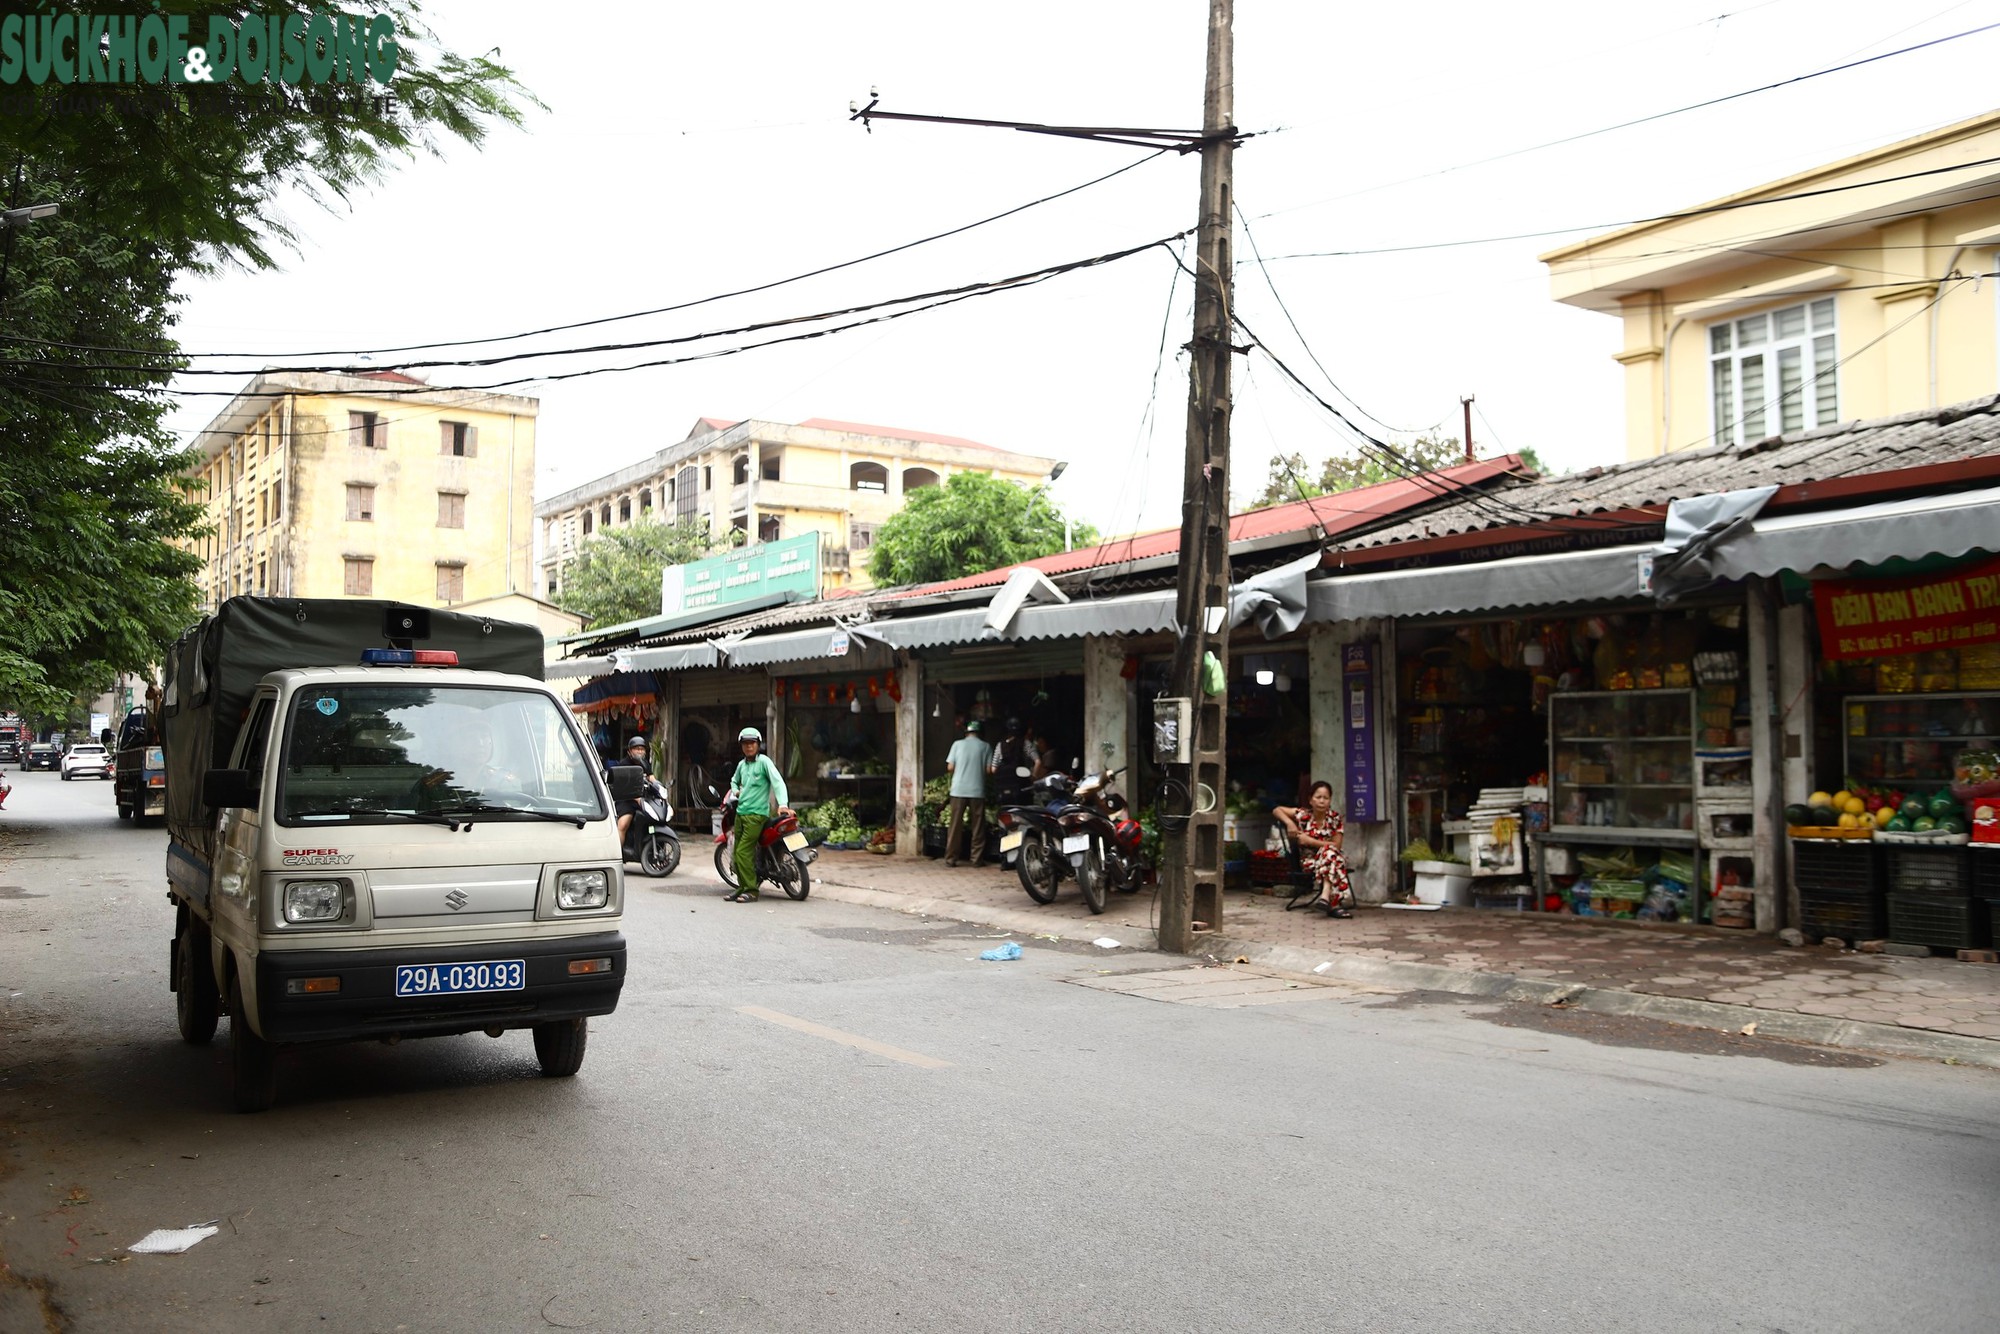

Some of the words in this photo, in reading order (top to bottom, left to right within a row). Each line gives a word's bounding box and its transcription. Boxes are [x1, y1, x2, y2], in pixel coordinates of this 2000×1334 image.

[283, 848, 339, 857] SUPER
[282, 855, 355, 866] CARRY
[400, 963, 522, 993] 29A-030.93
